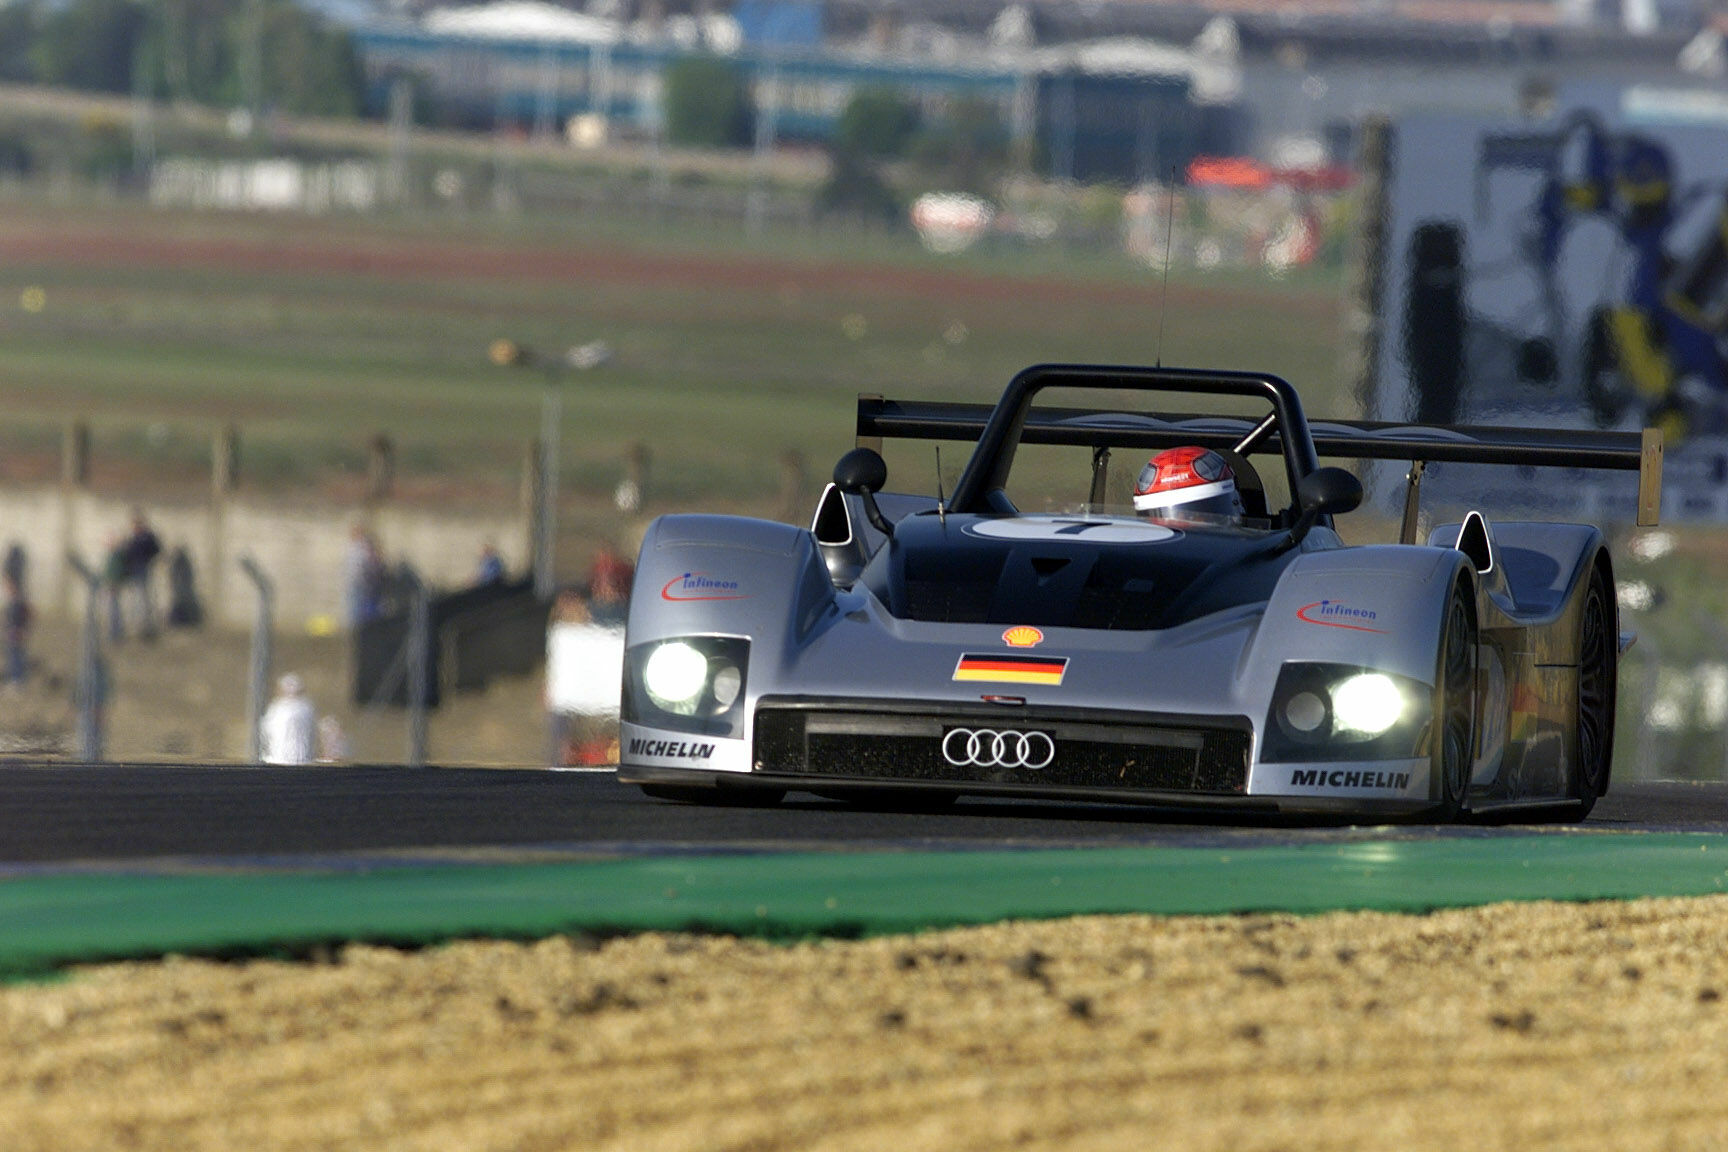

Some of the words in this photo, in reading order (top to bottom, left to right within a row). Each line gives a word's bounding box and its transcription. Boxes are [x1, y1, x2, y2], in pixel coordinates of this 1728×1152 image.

[1052, 520, 1112, 535] 7
[629, 738, 715, 759] MICHELIN
[1291, 769, 1410, 789] MICHELIN
